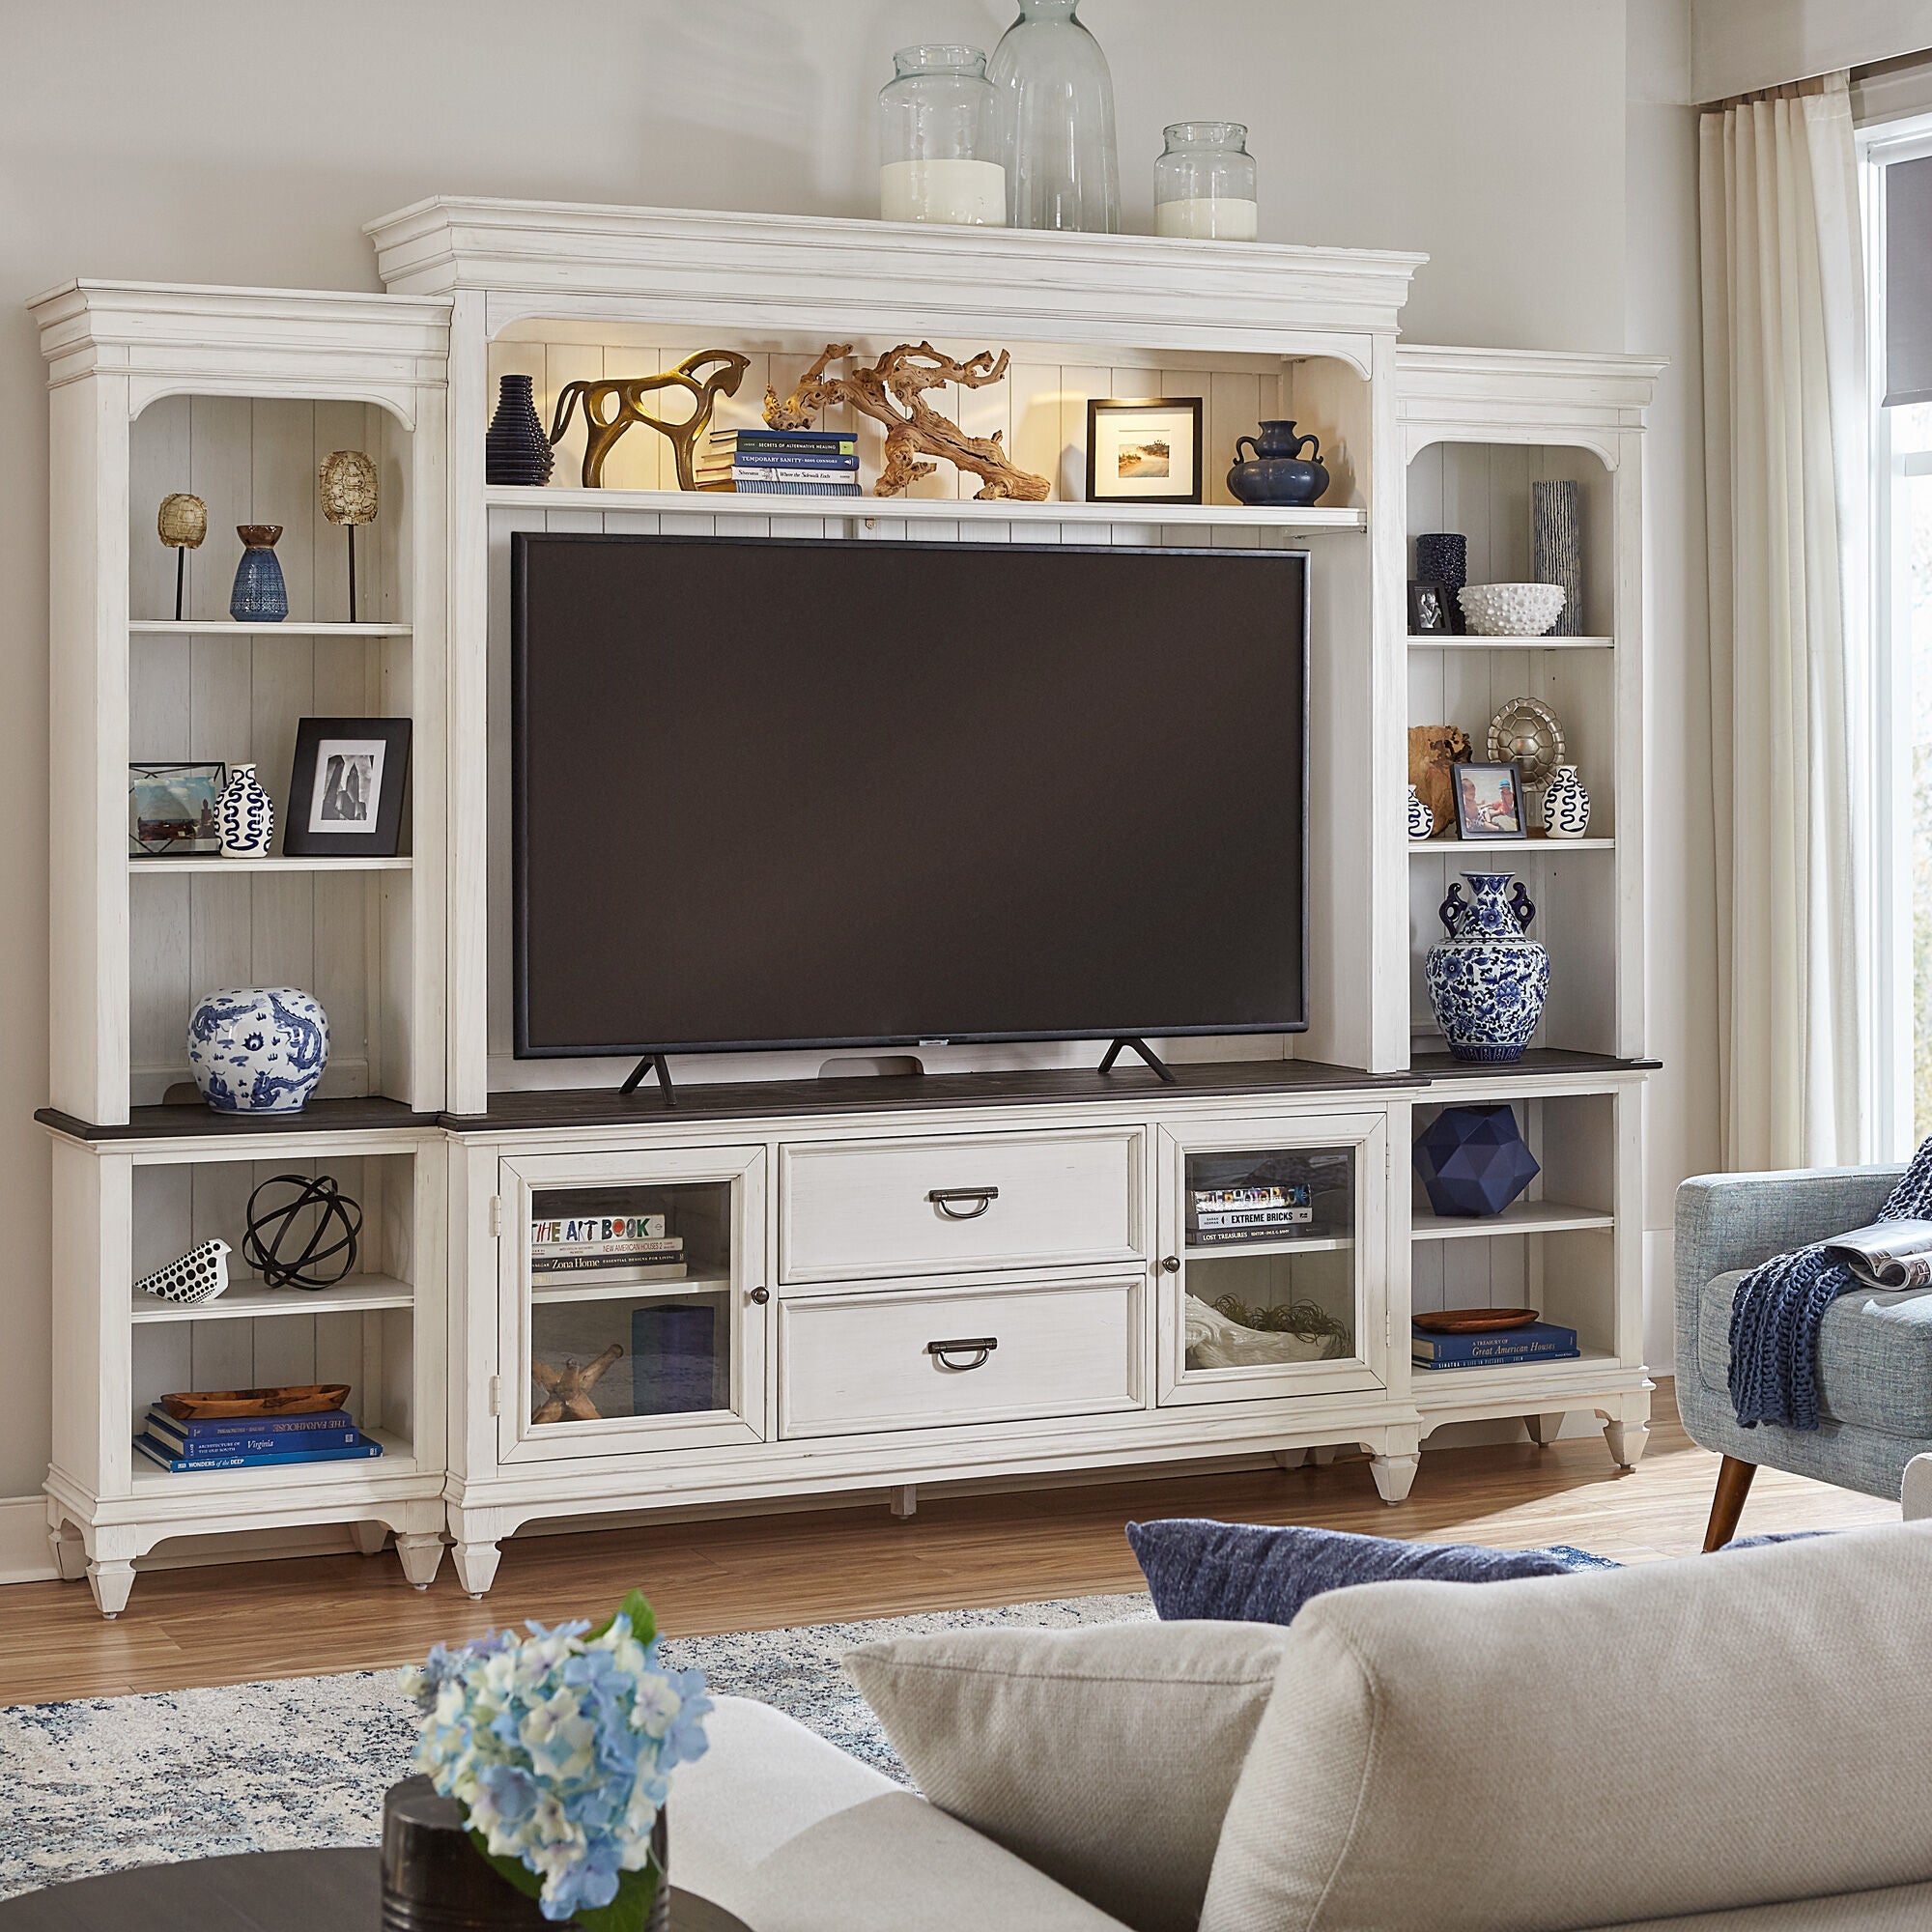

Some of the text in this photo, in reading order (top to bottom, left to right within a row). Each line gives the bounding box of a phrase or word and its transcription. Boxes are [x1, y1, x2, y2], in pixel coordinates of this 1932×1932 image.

[741, 455, 780, 464] TEMPORARY
[1231, 1211, 1293, 1224] EXTREME BRICKS
[566, 1220, 599, 1242] ART
[602, 1217, 650, 1240] BOOK
[1217, 1232, 1248, 1240] TREASURES
[614, 1243, 640, 1253] AMERICAN
[640, 1242, 659, 1251] HOUSES
[659, 1241, 663, 1250] 2
[552, 1259, 574, 1269] Zona
[575, 1258, 600, 1268] Home
[1472, 1341, 1555, 1356] Great American Houses
[272, 1420, 327, 1433] FARMHOUSE
[328, 1419, 346, 1430] THE
[247, 1439, 274, 1450] Virginia
[230, 1458, 244, 1466] DEEP
